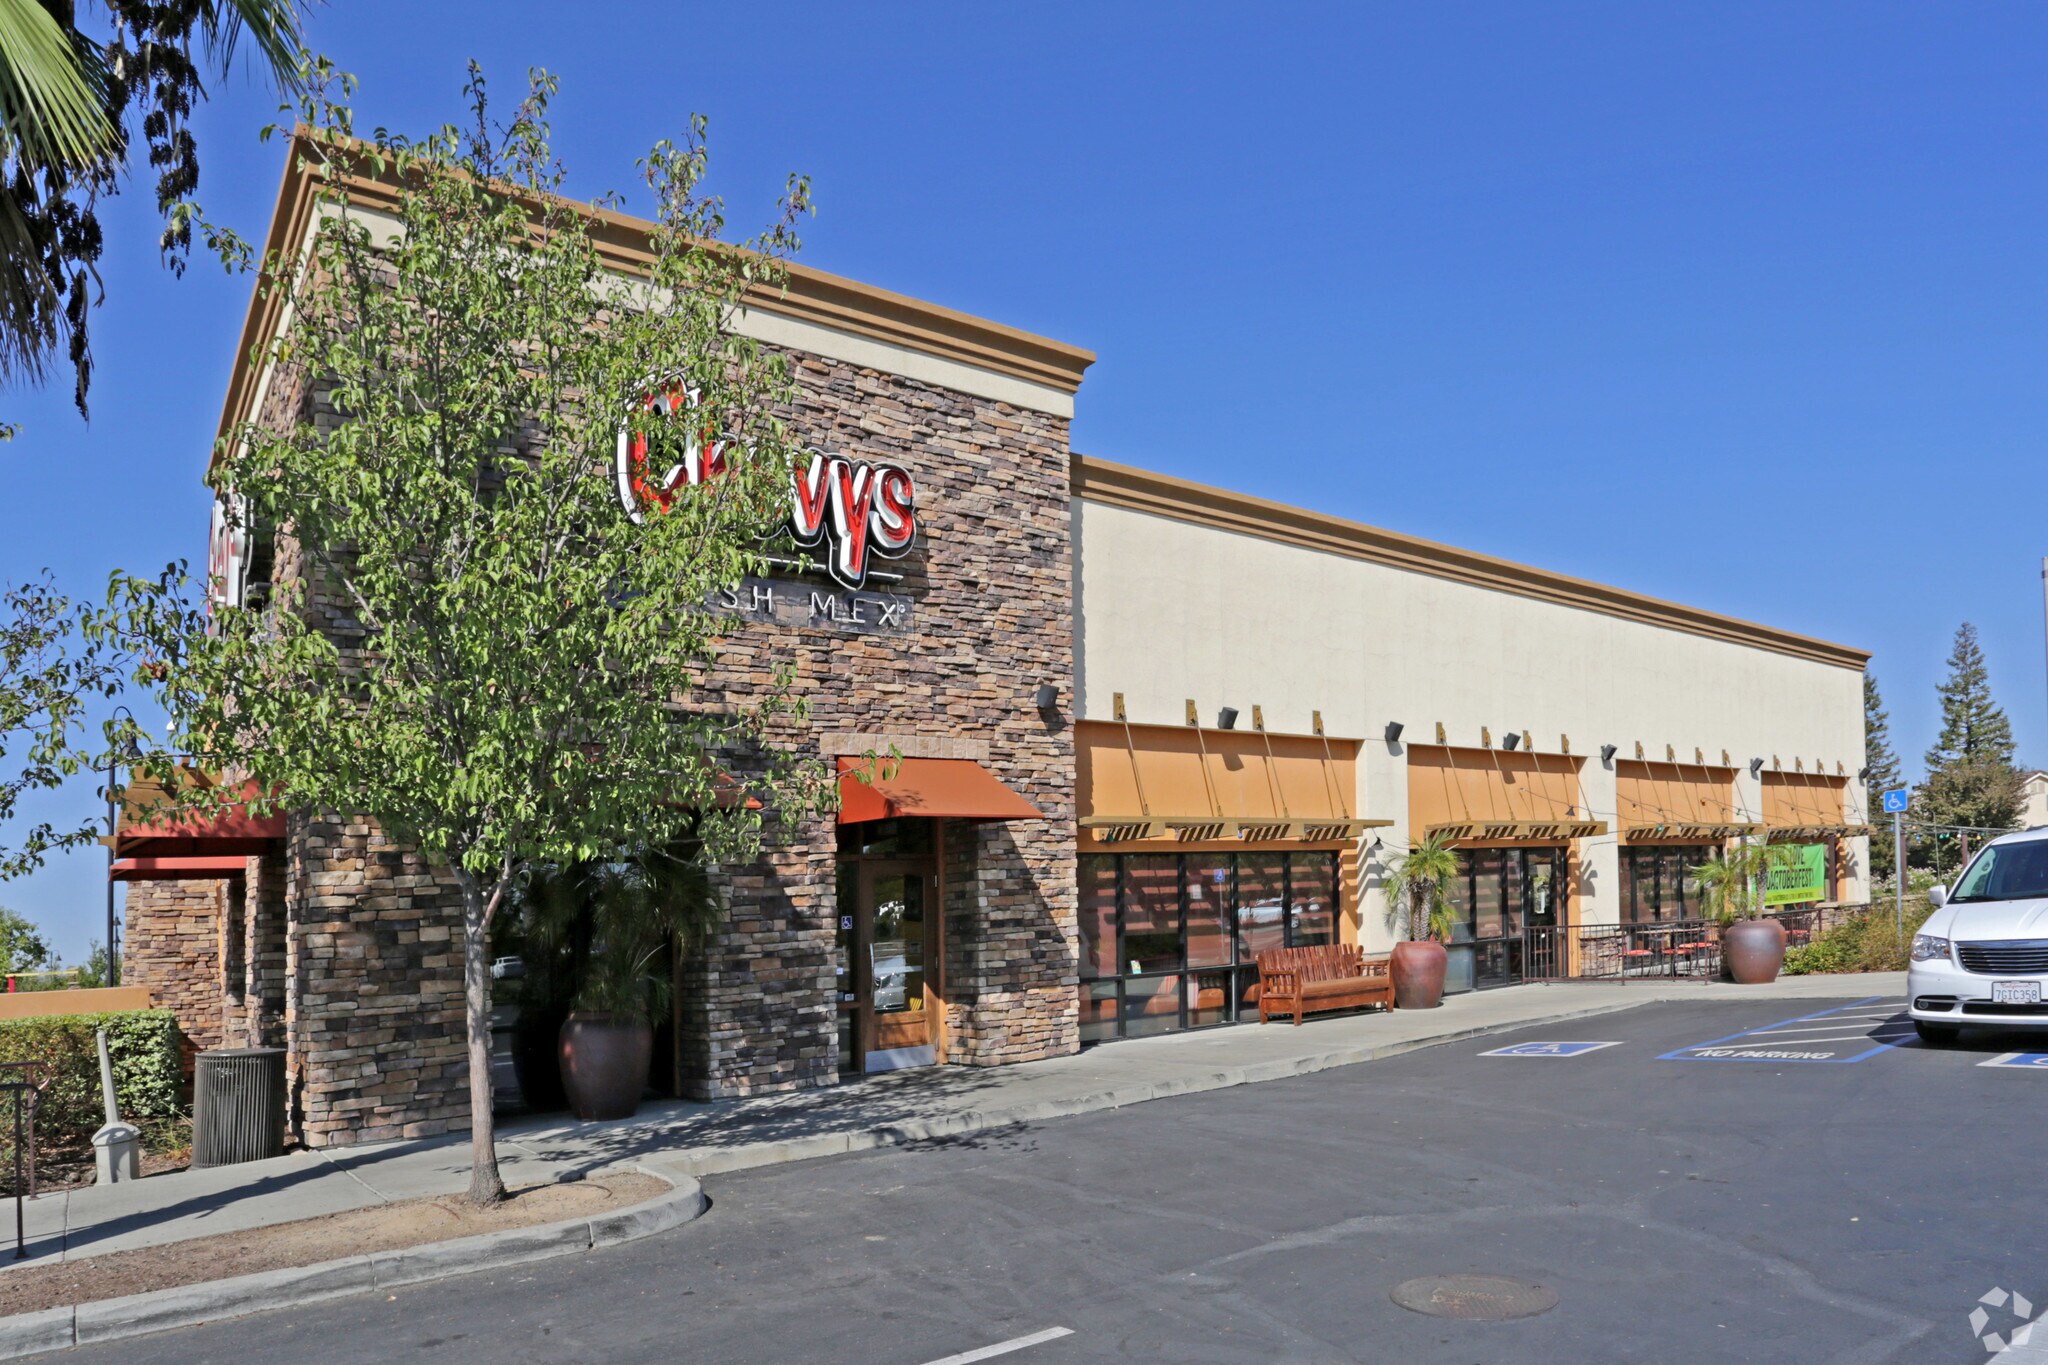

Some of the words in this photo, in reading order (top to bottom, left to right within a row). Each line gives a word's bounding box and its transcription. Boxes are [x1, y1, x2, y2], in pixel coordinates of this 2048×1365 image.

[809, 592, 900, 627] MEX
[1995, 989, 2038, 1000] 7GIC358
[1731, 1050, 1836, 1060] PARKING
